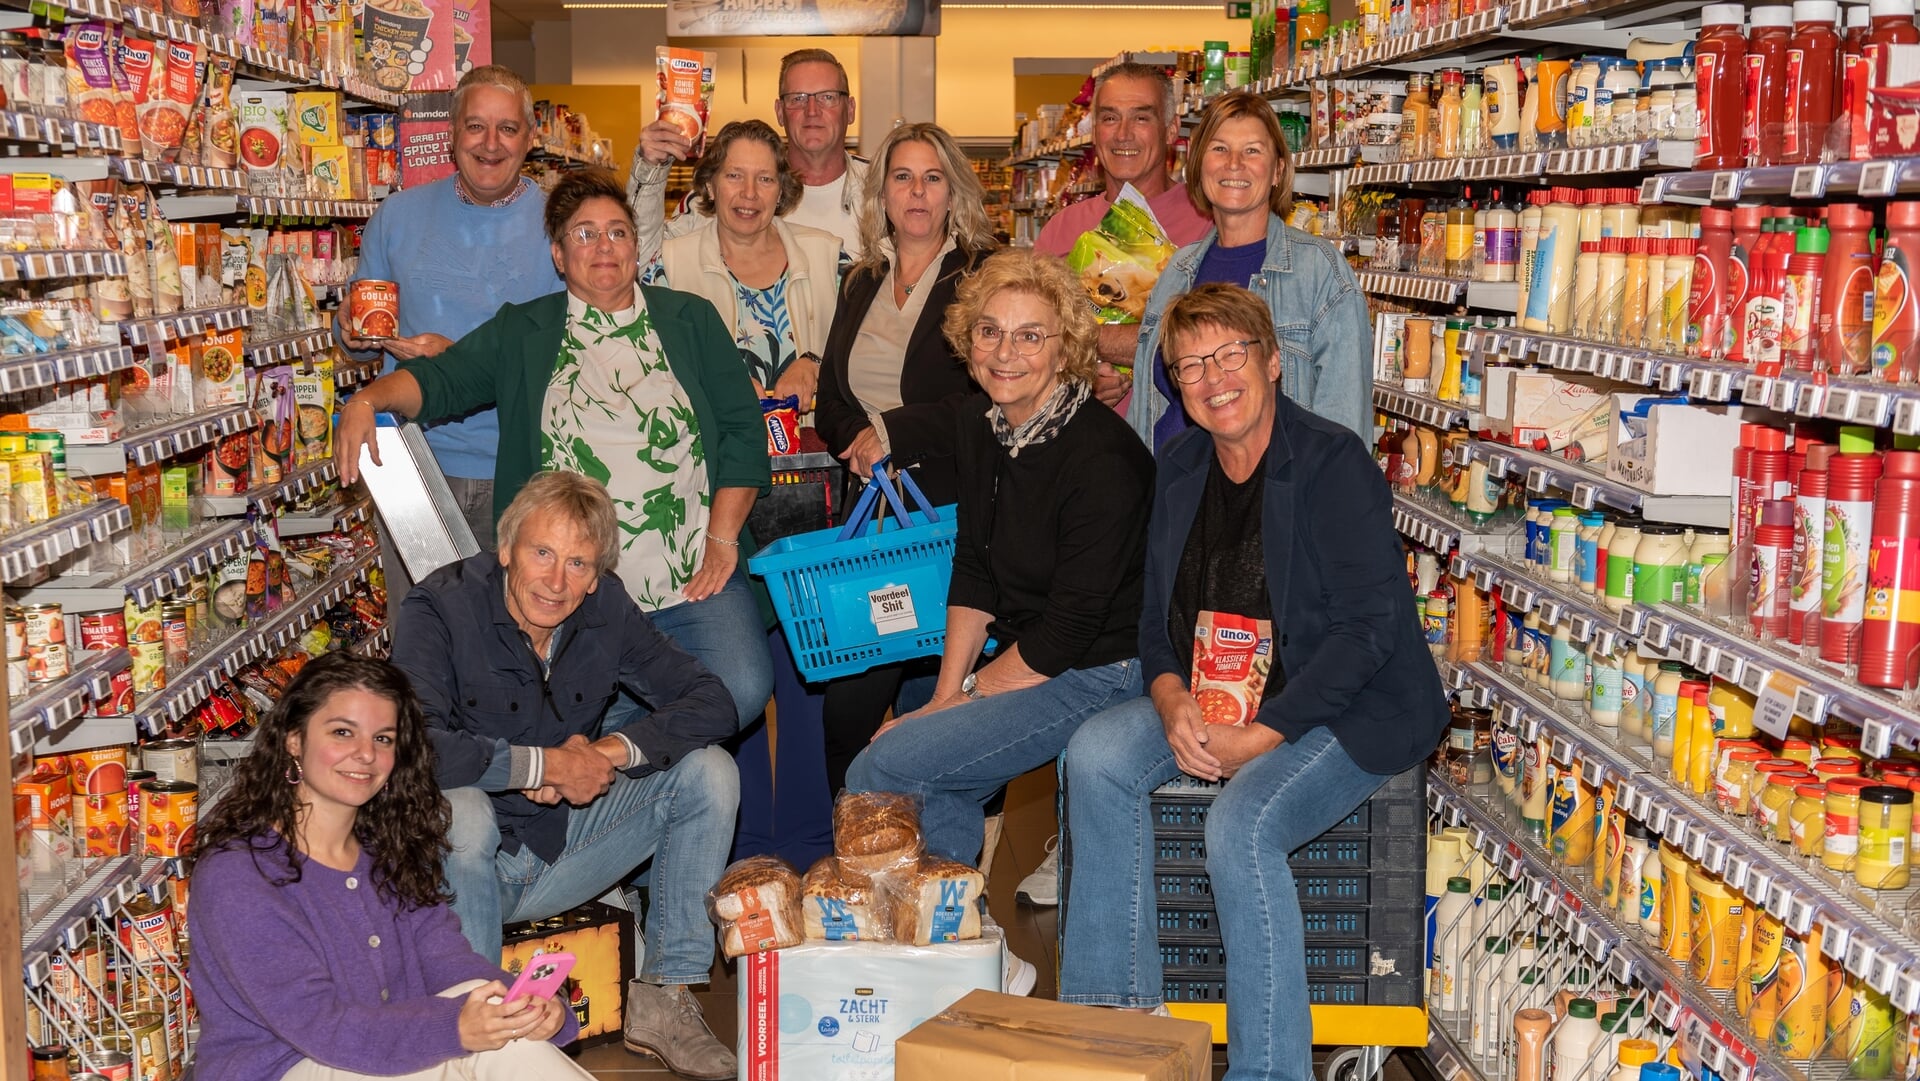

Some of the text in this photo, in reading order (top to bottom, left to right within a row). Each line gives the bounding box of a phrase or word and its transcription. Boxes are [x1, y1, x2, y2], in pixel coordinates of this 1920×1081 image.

[453, 9, 470, 21] EW!
[171, 46, 190, 61] unox
[675, 60, 697, 69] unox
[243, 106, 267, 116] BIO
[412, 110, 449, 118] namdon
[409, 131, 449, 143] GRAB IT!
[403, 143, 440, 156] SPICE
[408, 155, 438, 168] LOVE
[361, 291, 397, 302] GOULASH
[769, 418, 787, 451] McVitie's
[1618, 459, 1644, 483] MAYONAISE
[871, 588, 909, 603] Voordeel
[882, 600, 904, 613] Shit
[82, 625, 114, 635] TOMATEN
[1220, 629, 1251, 641] unox
[1214, 654, 1249, 665] KLASSIEKE
[1215, 662, 1242, 671] TOMATEN
[1497, 735, 1517, 745] Calv
[138, 916, 164, 929] unox
[1757, 924, 1775, 940] Frites
[839, 999, 889, 1014] ZACHT
[825, 1019, 831, 1027] 3
[848, 1014, 881, 1024] & STERK
[758, 999, 767, 1057] VOORDEEL
